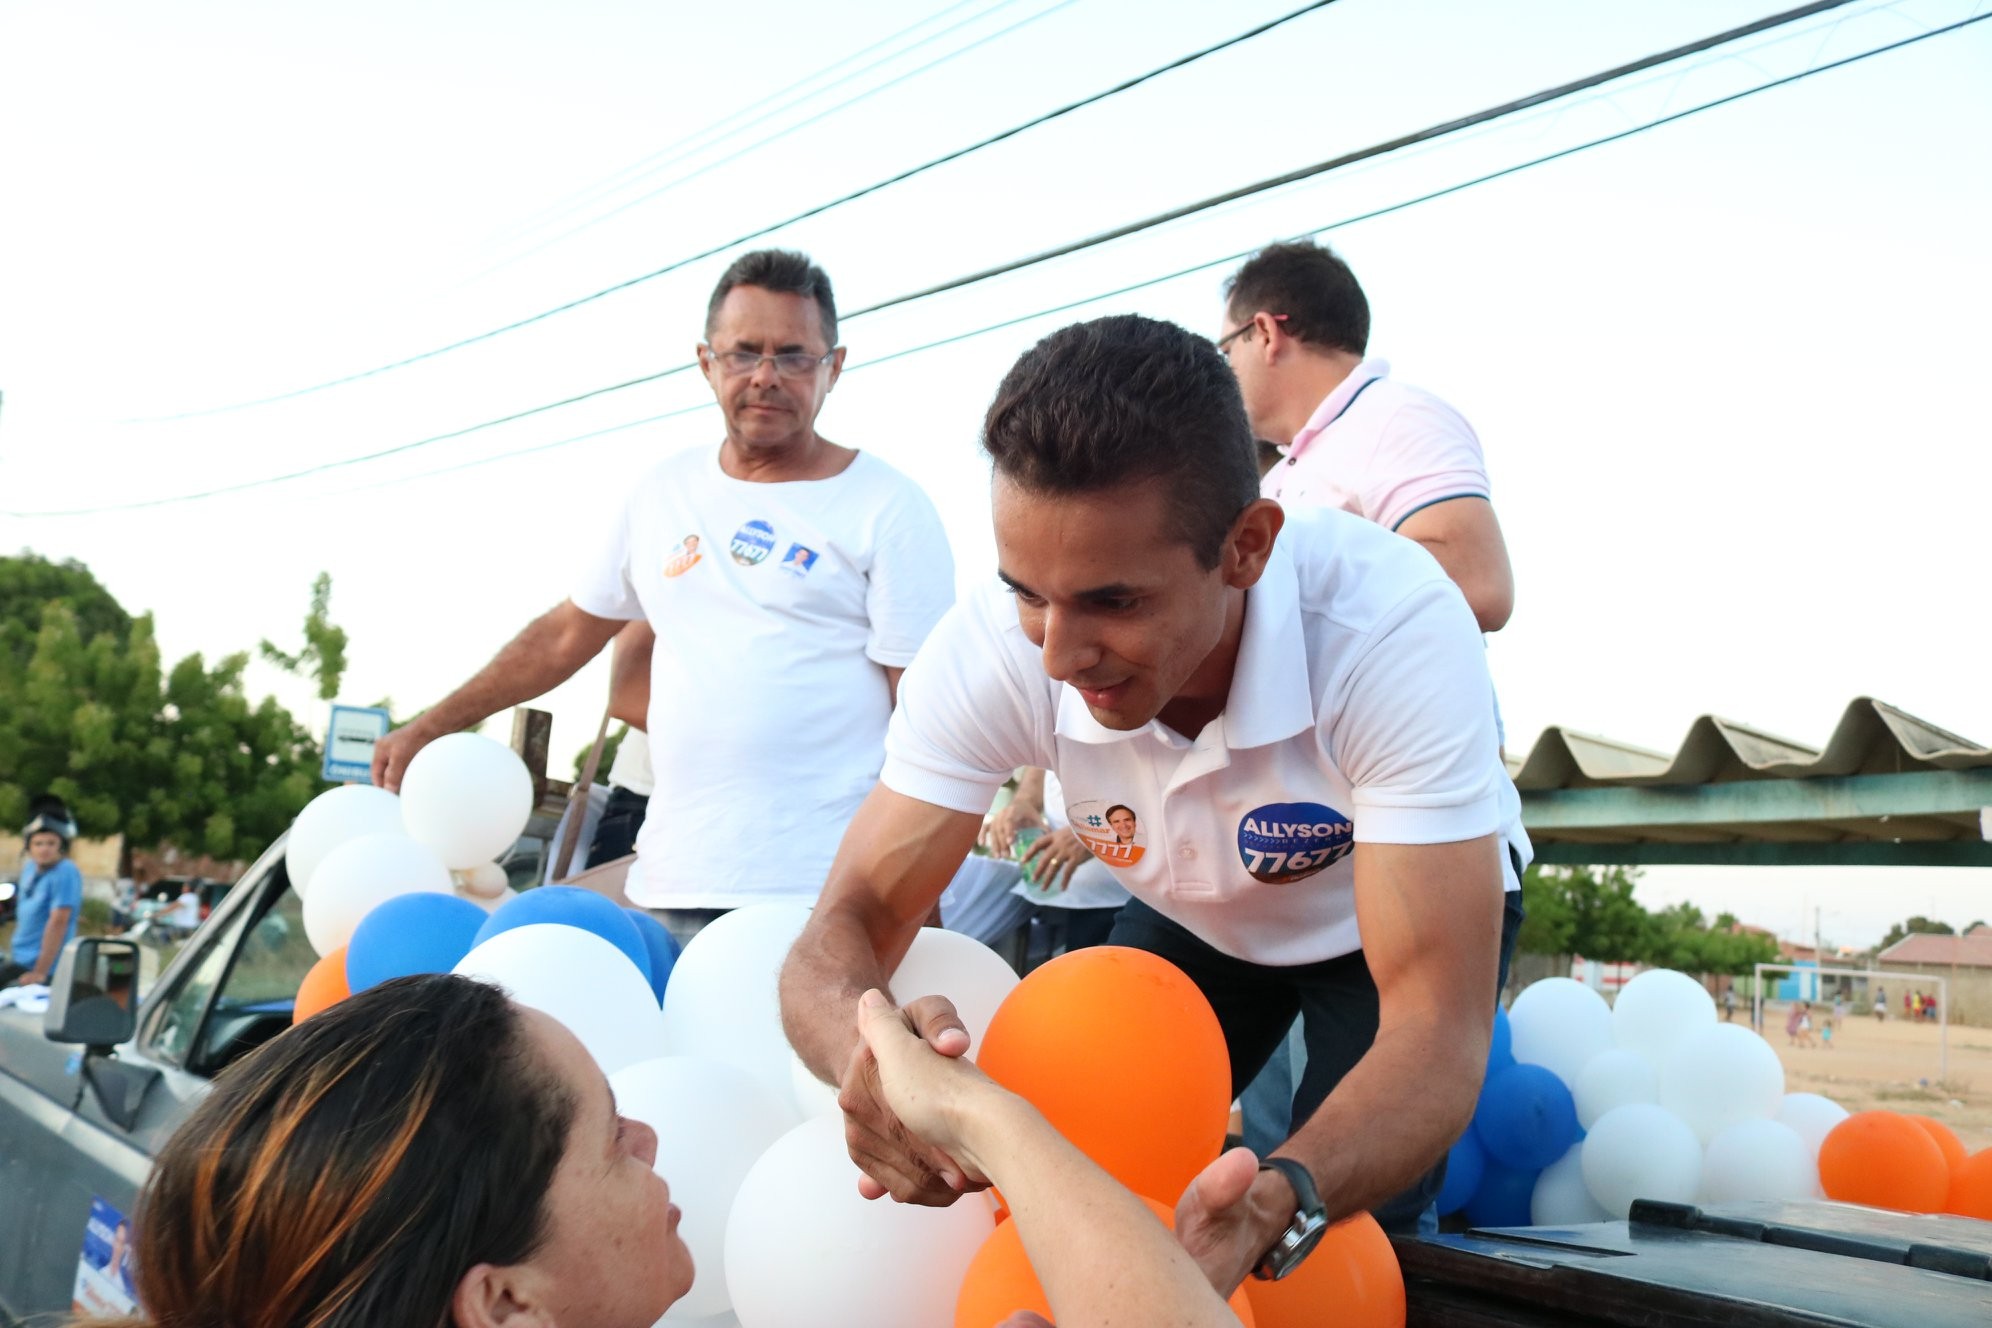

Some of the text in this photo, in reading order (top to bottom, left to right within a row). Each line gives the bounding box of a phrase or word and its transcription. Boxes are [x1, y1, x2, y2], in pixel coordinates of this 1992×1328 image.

[1243, 817, 1353, 838] ALLYSON
[1086, 838, 1133, 859] 7777
[1244, 841, 1354, 874] 77677
